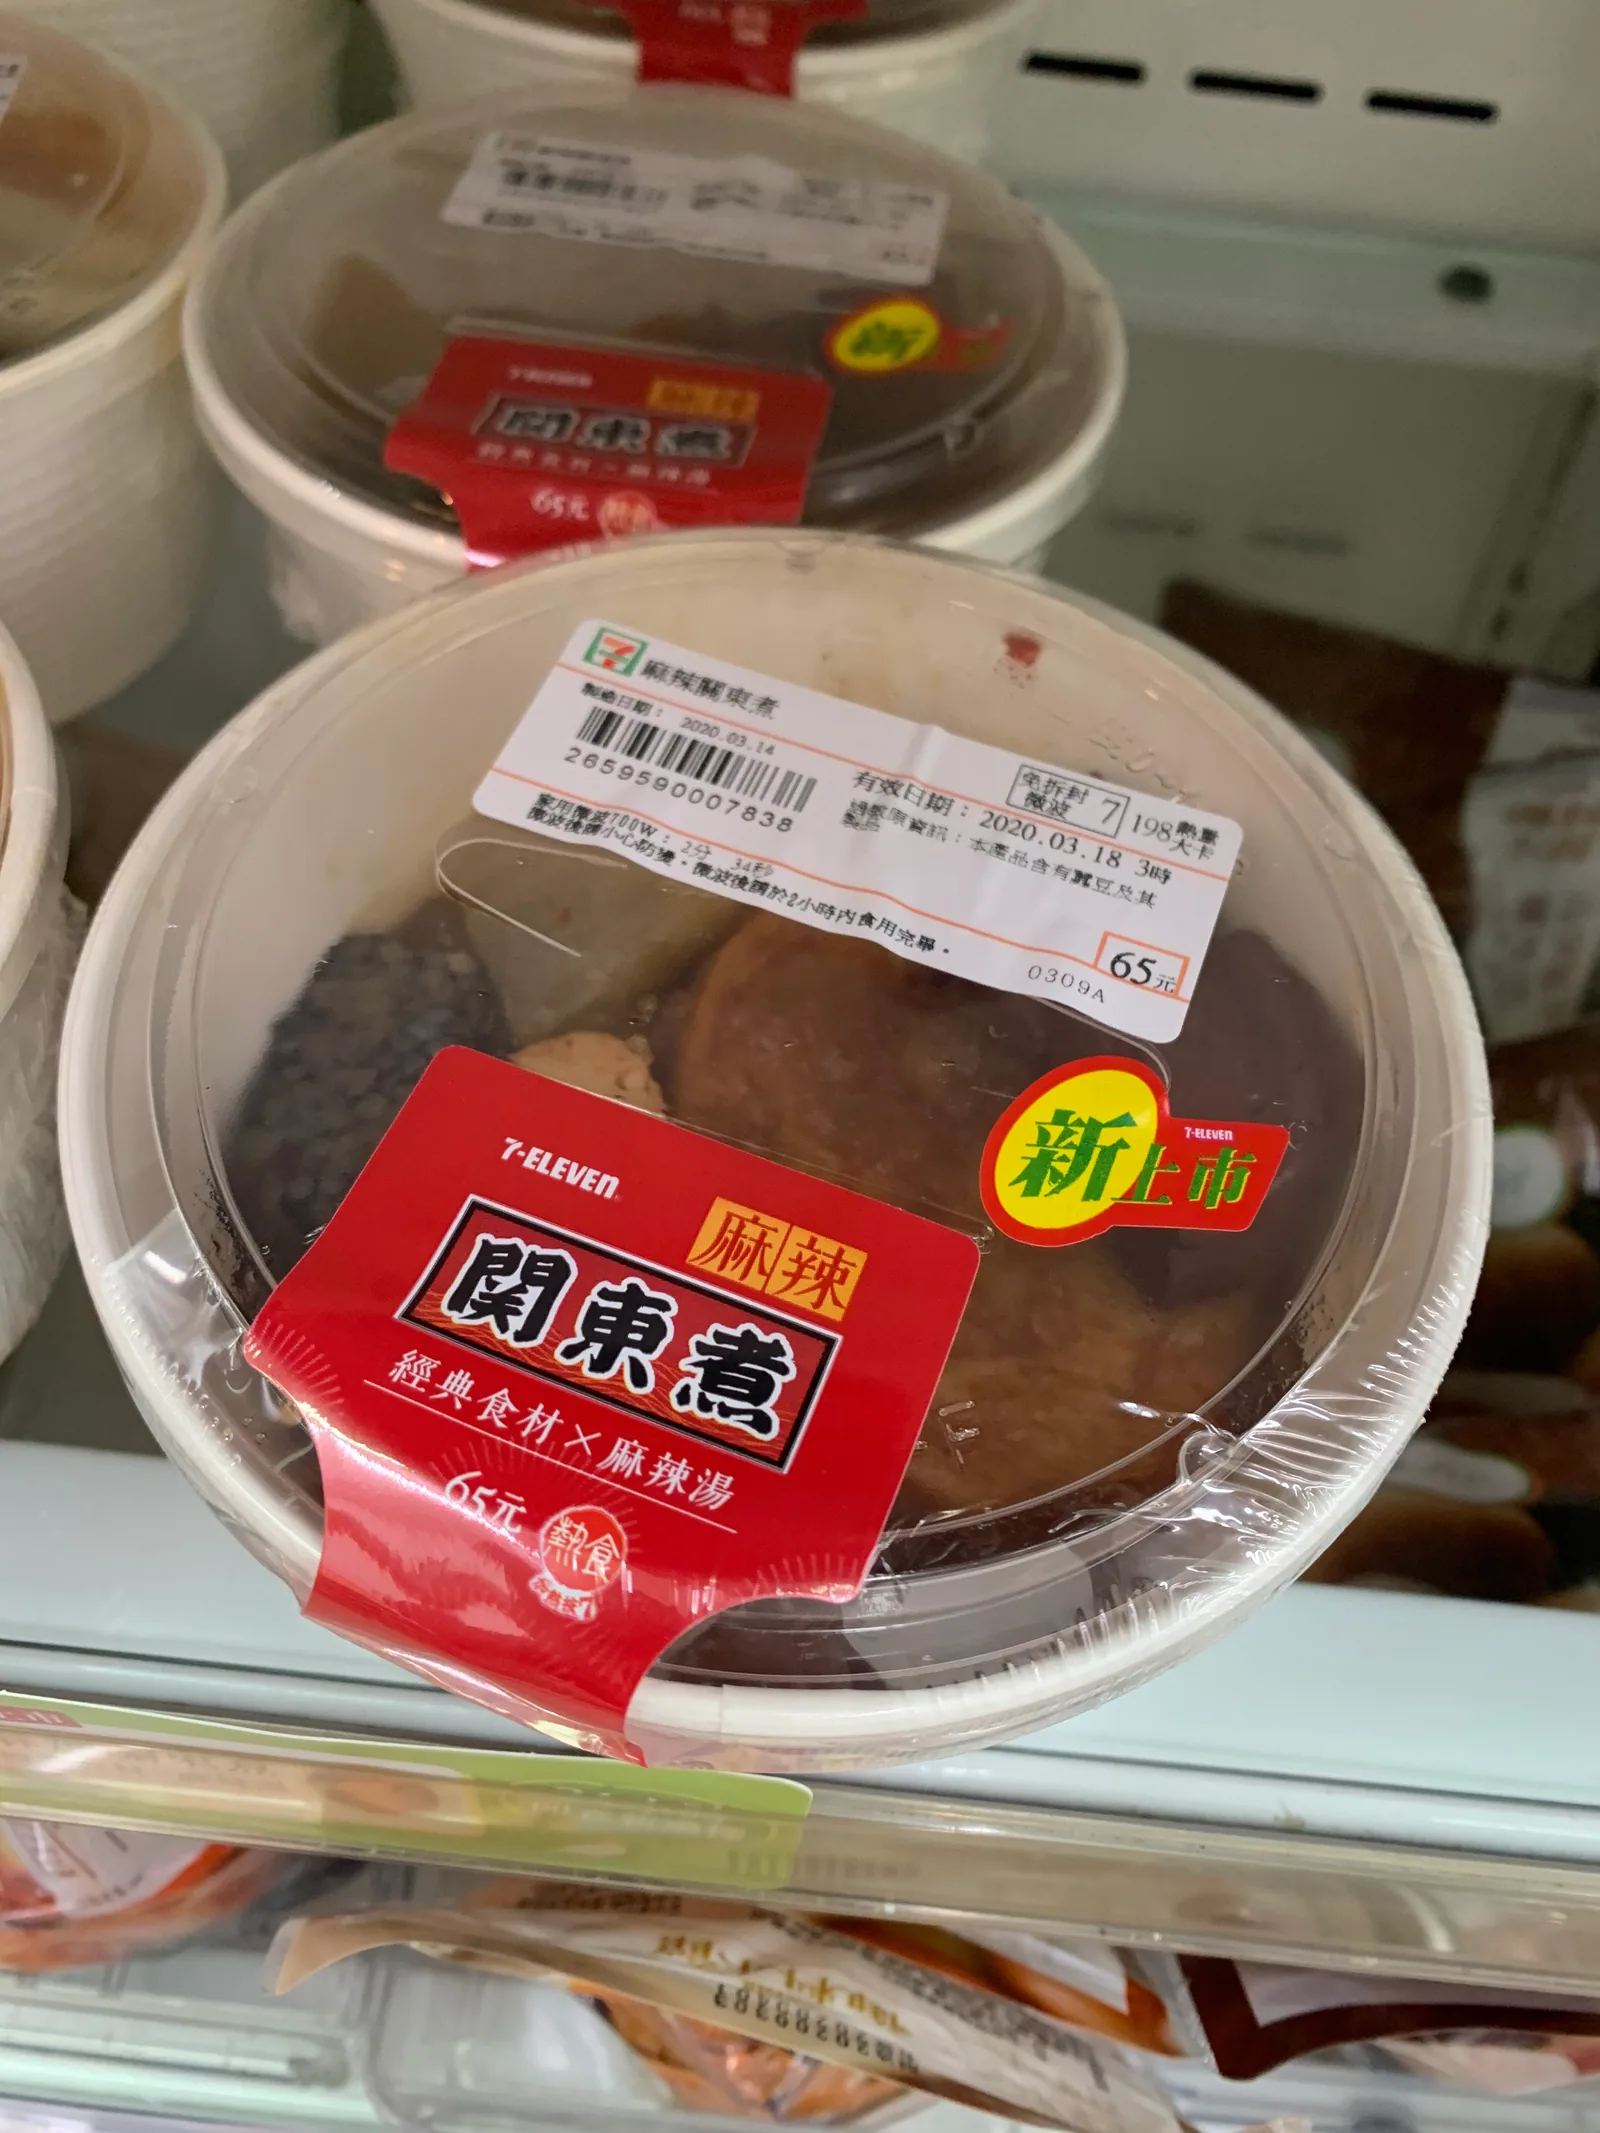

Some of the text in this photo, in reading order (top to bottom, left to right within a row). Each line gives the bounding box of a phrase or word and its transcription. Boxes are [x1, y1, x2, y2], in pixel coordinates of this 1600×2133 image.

[680, 716, 777, 757] 2020.03.14
[564, 746, 796, 834] 2659590007838
[1099, 799, 1123, 827] 7
[978, 811, 1123, 870] 2020.03.18
[1130, 812, 1172, 843] 198
[1025, 963, 1107, 1005] 0309A
[1183, 1125, 1234, 1142] 7-ELEVEN
[499, 1135, 622, 1200] 7-ELEVEN
[690, 1210, 858, 1312] 麻辣
[443, 1469, 528, 1535] 65元
[547, 1514, 622, 1583] 熱食
